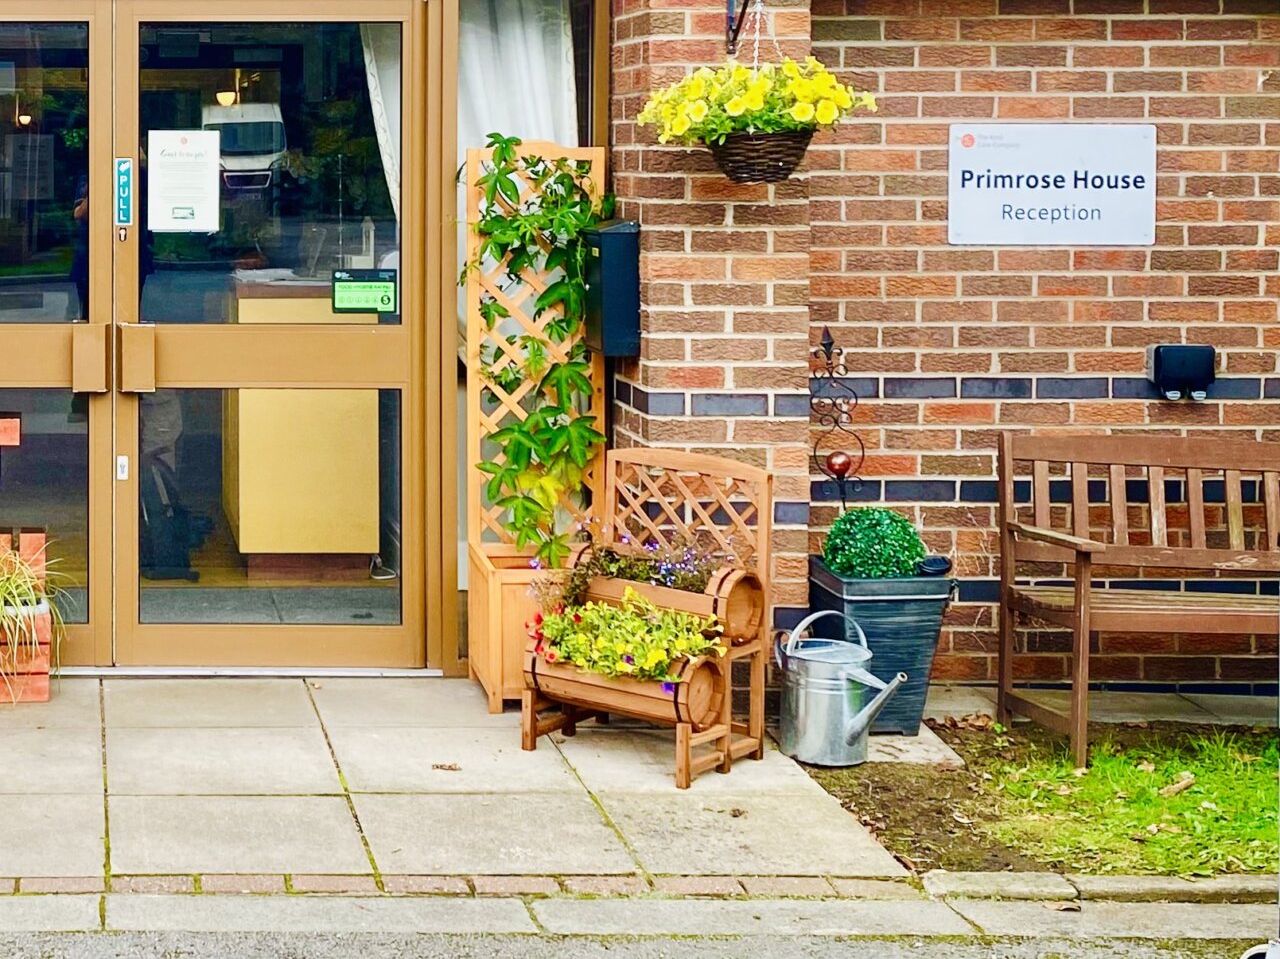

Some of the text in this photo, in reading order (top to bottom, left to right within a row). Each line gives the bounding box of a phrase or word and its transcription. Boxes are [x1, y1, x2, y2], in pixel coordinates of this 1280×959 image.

[961, 169, 1146, 189] Primrose House
[119, 175, 129, 221] PULL
[1002, 203, 1102, 224] Reception
